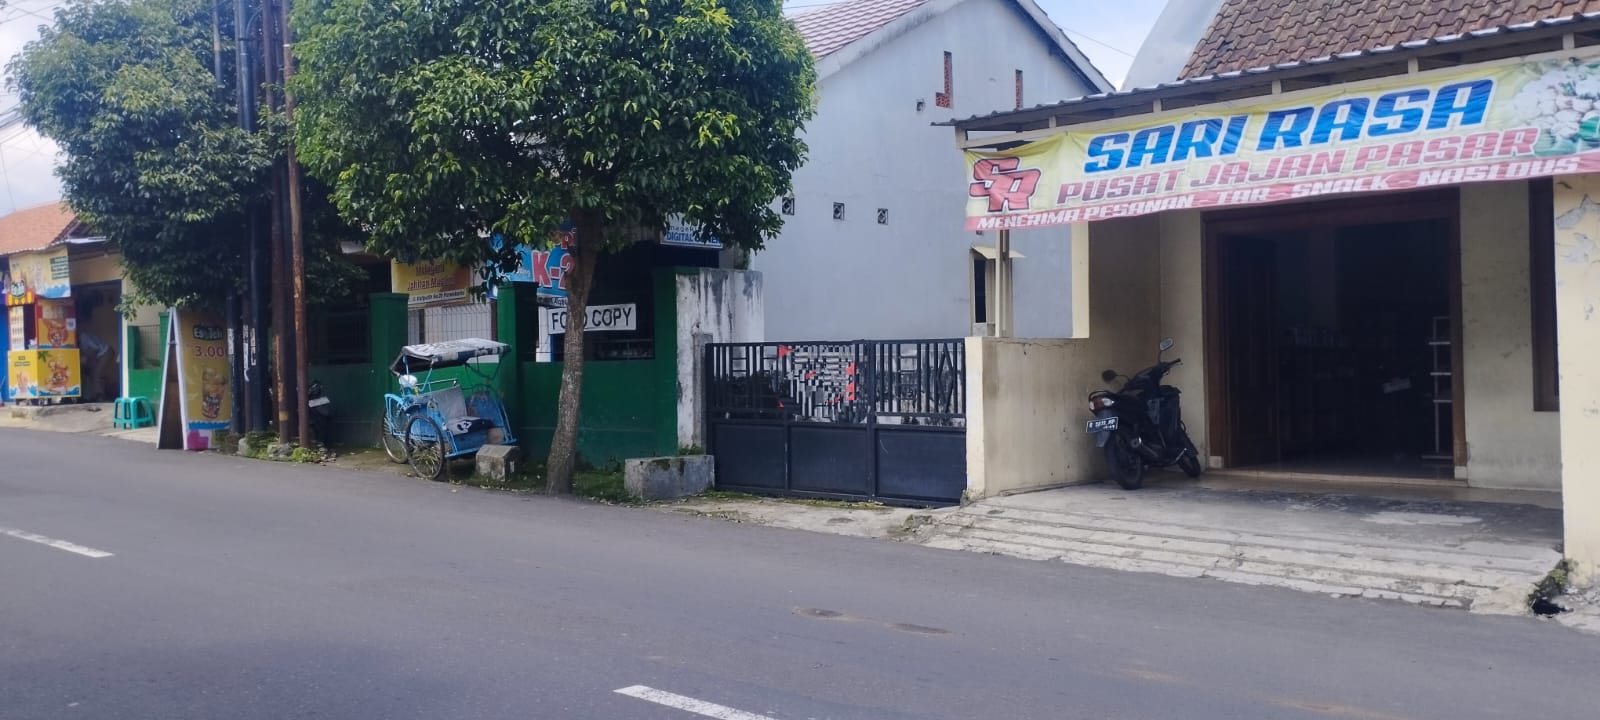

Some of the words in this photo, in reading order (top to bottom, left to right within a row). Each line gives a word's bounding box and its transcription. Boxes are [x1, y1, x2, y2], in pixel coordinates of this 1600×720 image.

[1084, 115, 1249, 174] SARI
[1255, 78, 1495, 152] RASA
[1056, 168, 1186, 205] PUSAT
[1190, 150, 1347, 188] JAJAN
[1352, 126, 1540, 172] PASAR
[976, 208, 1082, 230] MENERIMA
[1084, 194, 1193, 219] PESANAN
[1217, 187, 1270, 205] TAR
[1290, 175, 1390, 199] SNACK
[592, 307, 632, 327] COPY
[194, 345, 227, 358] 3.00
